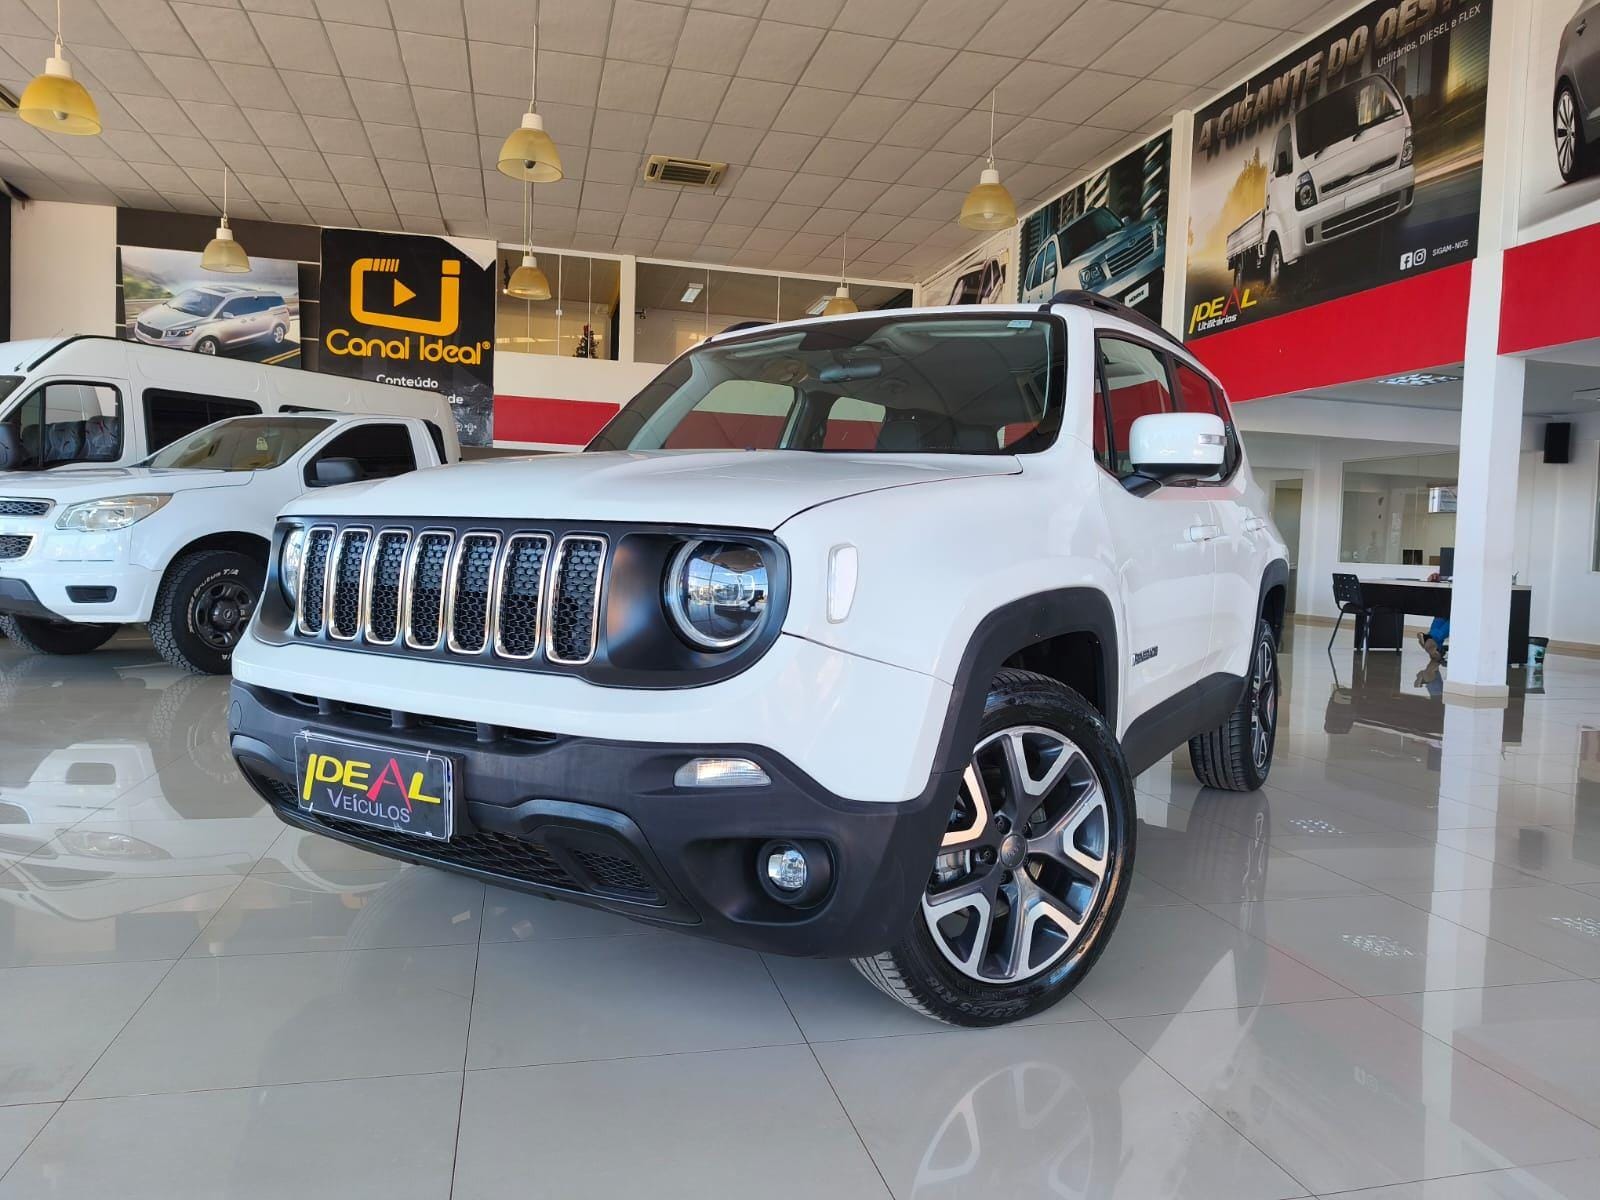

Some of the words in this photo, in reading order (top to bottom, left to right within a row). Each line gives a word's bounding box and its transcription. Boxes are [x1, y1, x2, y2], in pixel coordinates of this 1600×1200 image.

[1419, 24, 1450, 46] DIESEL
[1458, 3, 1481, 24] FLEX
[1198, 117, 1216, 149] A
[1218, 50, 1325, 138] GIGANTE
[1327, 25, 1368, 76] DO
[1375, 0, 1464, 45] OES
[1188, 287, 1258, 335] IDEAL
[326, 328, 410, 360] Canal
[376, 373, 439, 389] Conteúdo
[302, 753, 441, 814] IDEAL
[326, 787, 411, 823] VEÍCULOS
